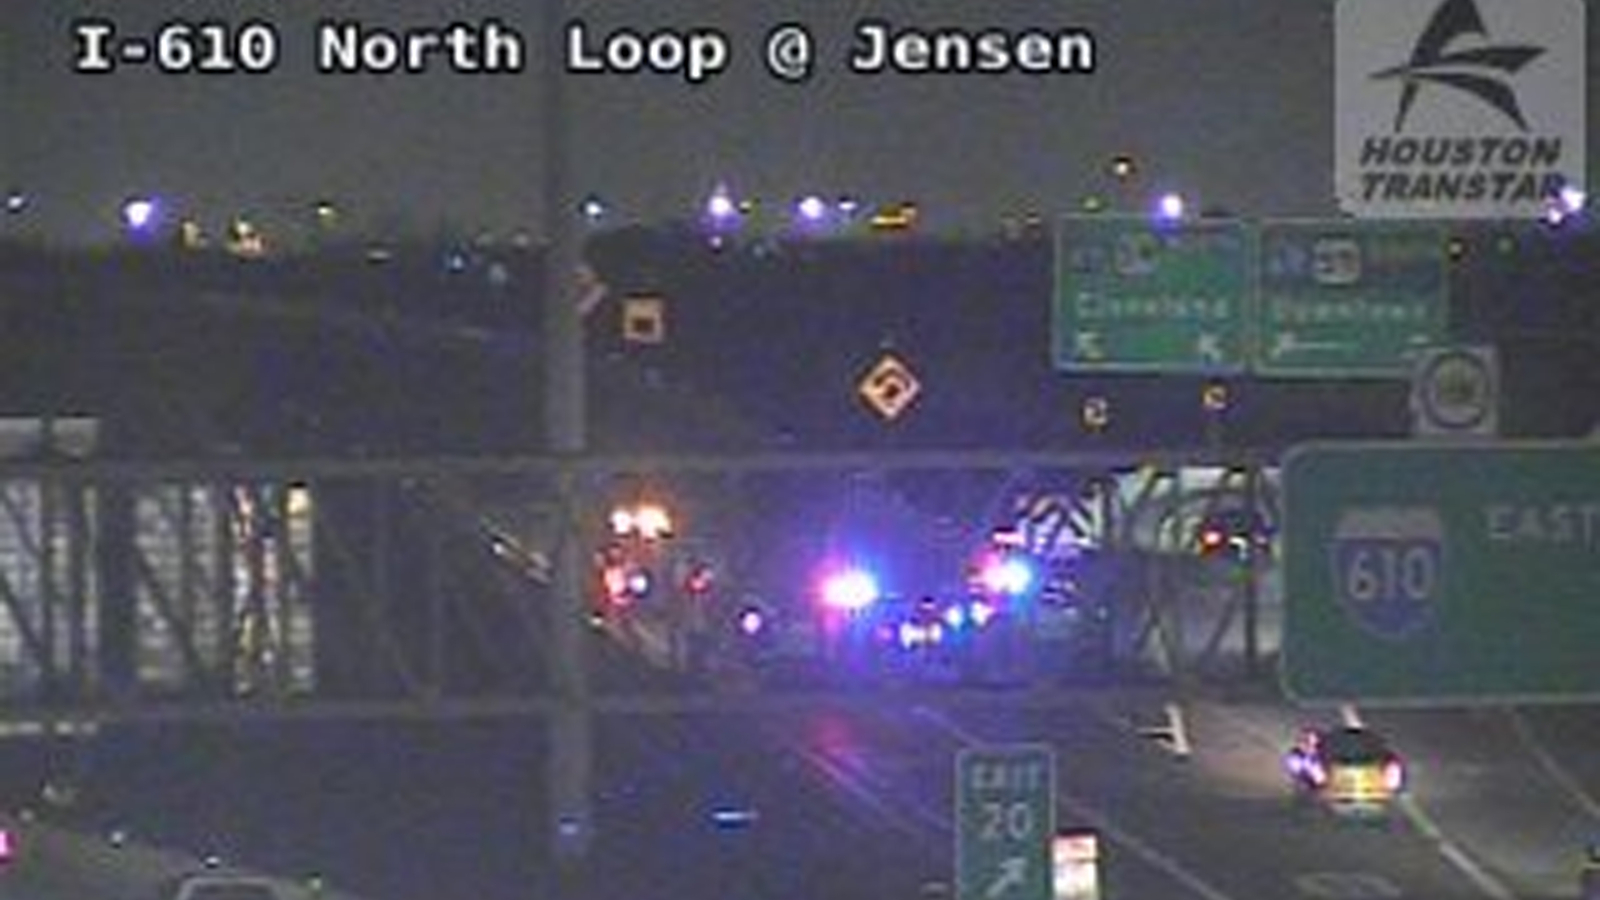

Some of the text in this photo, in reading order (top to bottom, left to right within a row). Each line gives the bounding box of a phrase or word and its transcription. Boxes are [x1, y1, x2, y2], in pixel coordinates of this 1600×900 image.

[1488, 505, 1600, 540] EAST
[1350, 547, 1432, 600] 610
[971, 763, 1041, 790] EXIT
[978, 802, 1032, 840] 20
